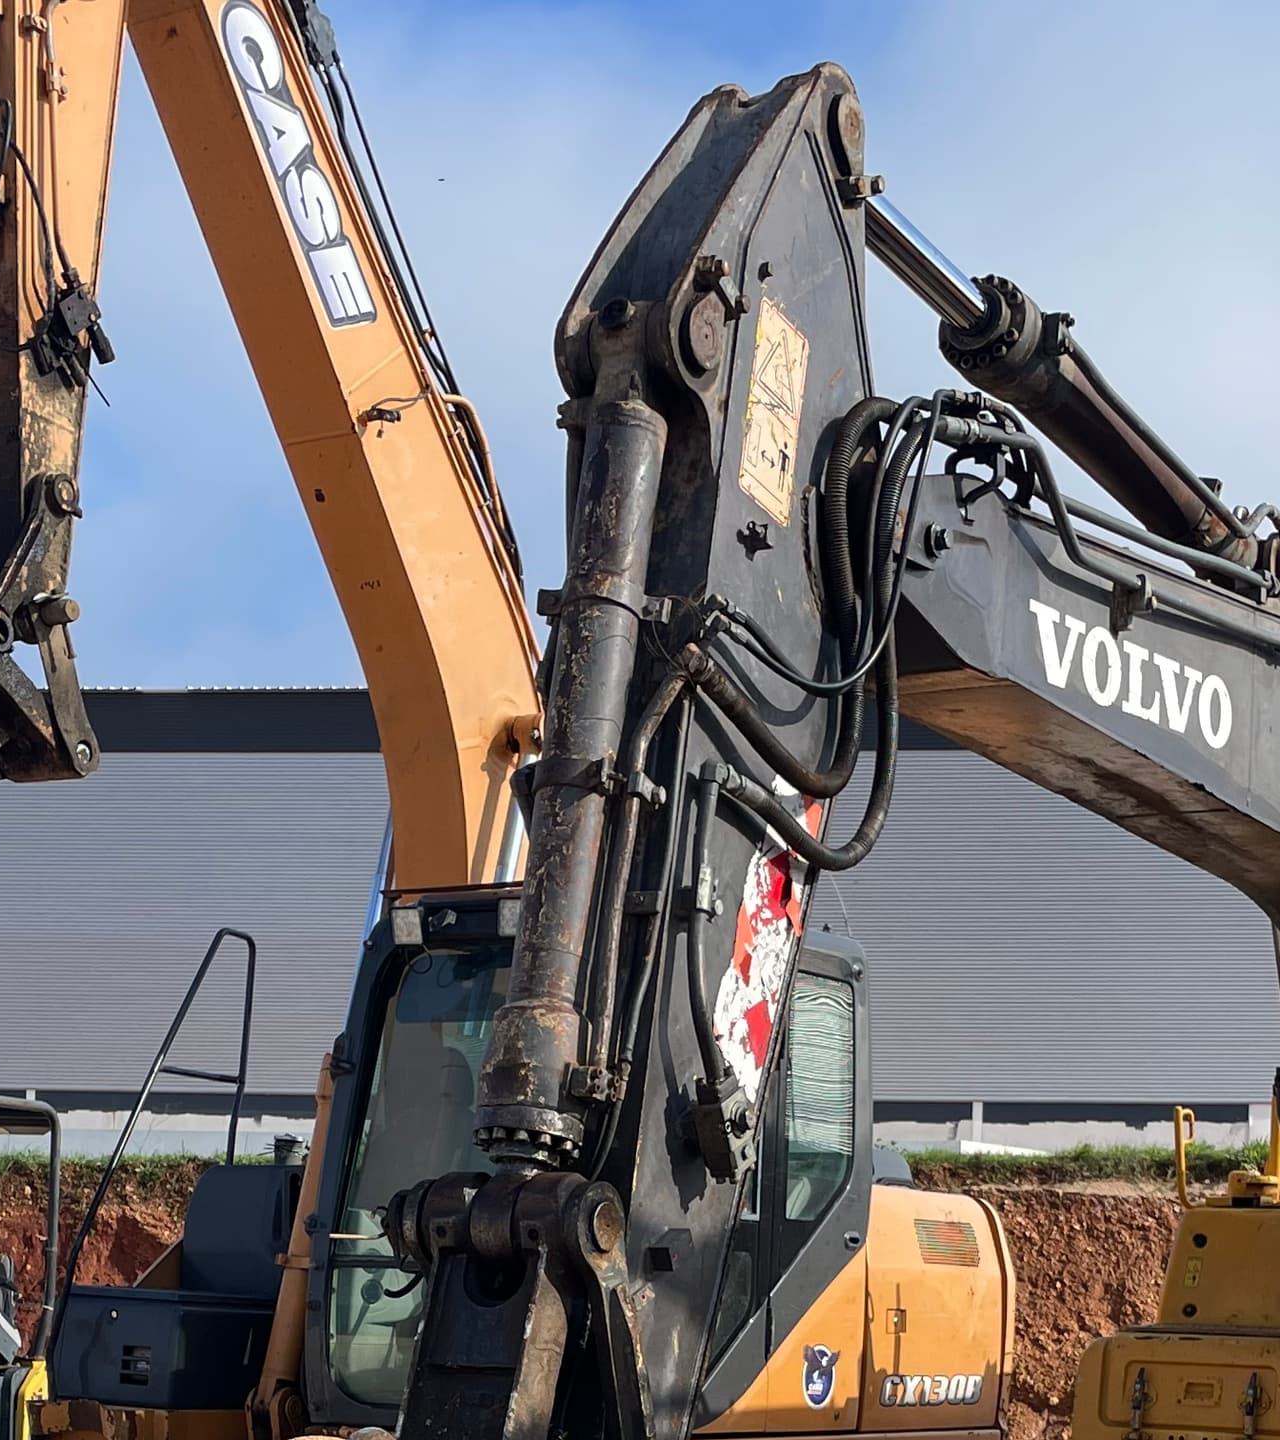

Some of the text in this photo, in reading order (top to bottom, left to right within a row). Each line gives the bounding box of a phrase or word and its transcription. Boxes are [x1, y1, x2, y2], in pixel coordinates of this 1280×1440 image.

[223, 4, 376, 323] CASE
[1029, 599, 1232, 749] VOLVO
[879, 1375, 985, 1407] CX130B
